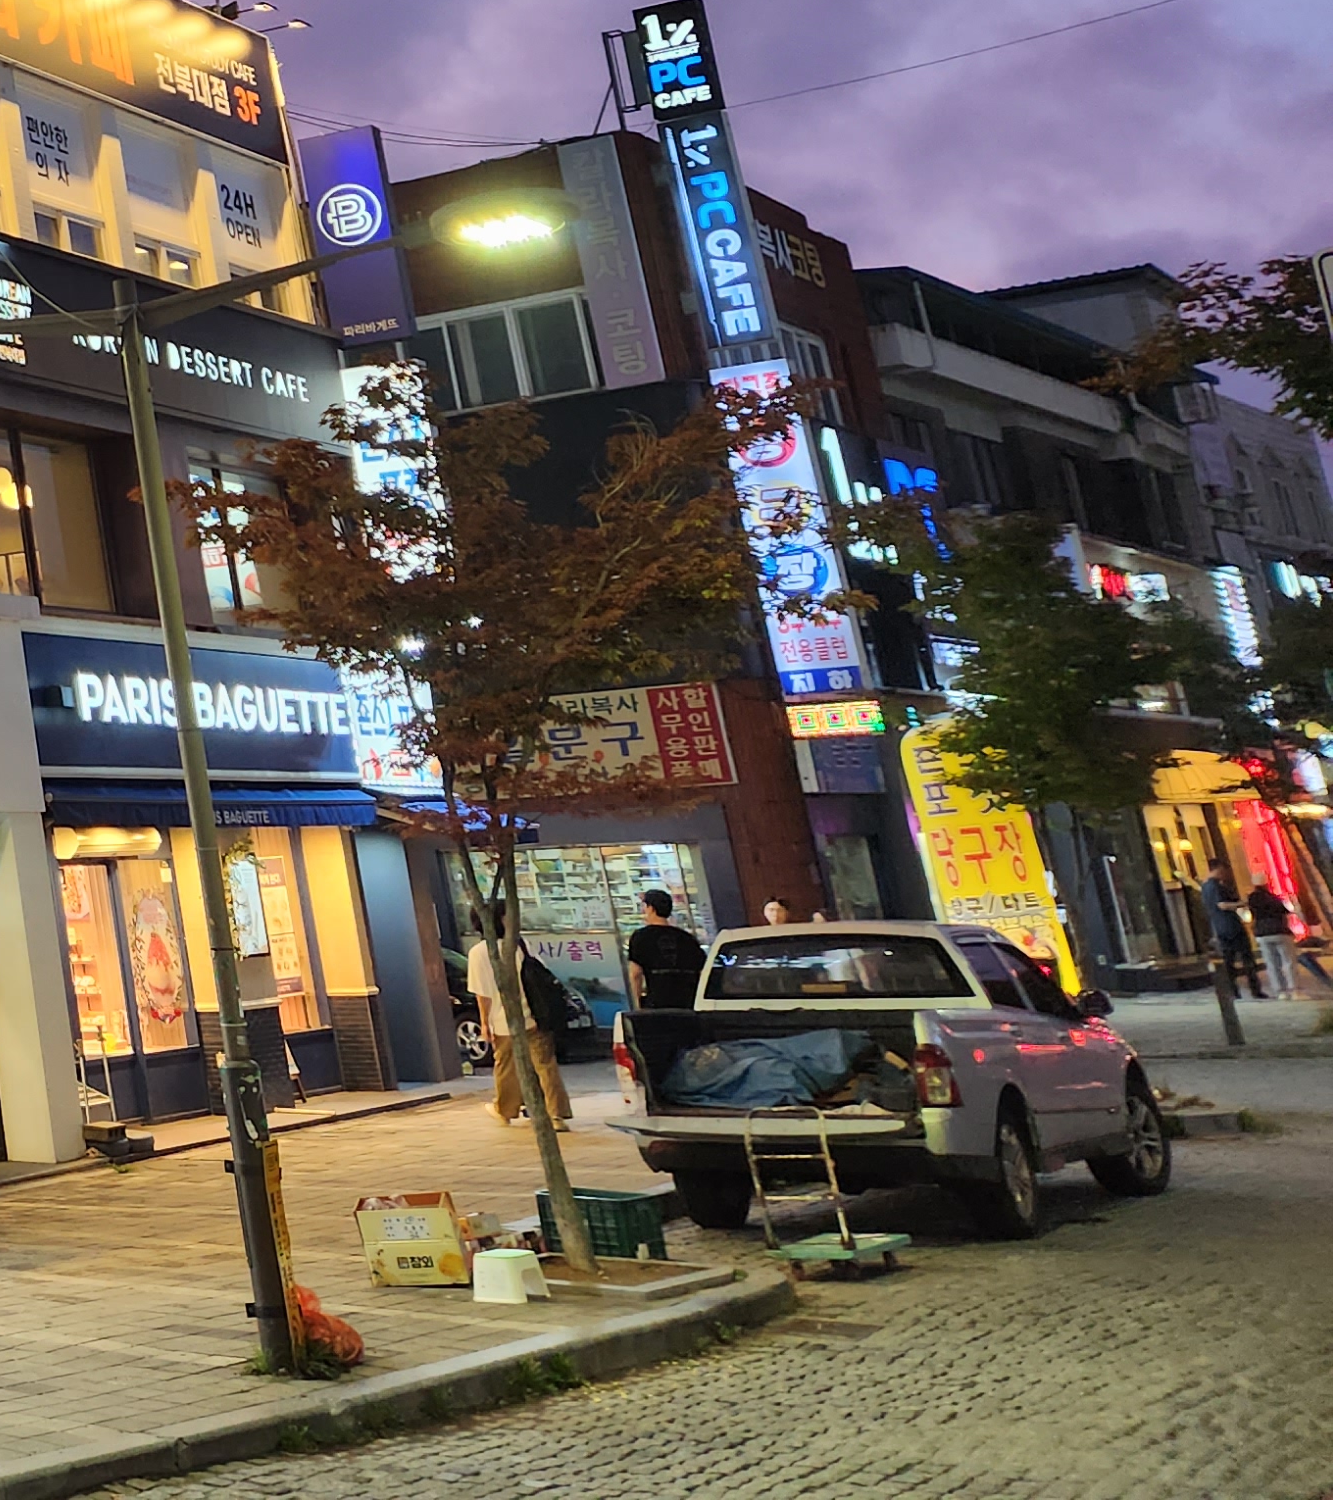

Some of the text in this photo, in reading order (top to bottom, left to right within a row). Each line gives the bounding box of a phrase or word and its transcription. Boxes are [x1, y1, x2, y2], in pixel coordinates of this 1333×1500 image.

[641, 14, 697, 51] 1%
[155, 52, 261, 126] 전북대점 3F
[649, 56, 705, 92] PC
[655, 85, 712, 109] CAFE
[26, 115, 70, 156] 편안한
[35, 155, 70, 187] 의자
[220, 184, 256, 220] 24H
[690, 171, 736, 229] PC
[225, 220, 262, 248] OPEN
[705, 228, 761, 336] CAFE
[342, 319, 399, 336] 파리바게뜨
[606, 309, 647, 375] 코팅
[167, 344, 310, 403] DESSERT CAFE
[780, 637, 848, 664] 전용클럽
[790, 670, 854, 693] 지하
[77, 672, 350, 735] PARIS BAGUETTE
[554, 693, 639, 716] 라복사
[683, 686, 722, 780] 할인판매
[224, 809, 269, 825] BAGUETTE
[929, 821, 1027, 887] 당구장
[538, 940, 604, 962] 사/출력
